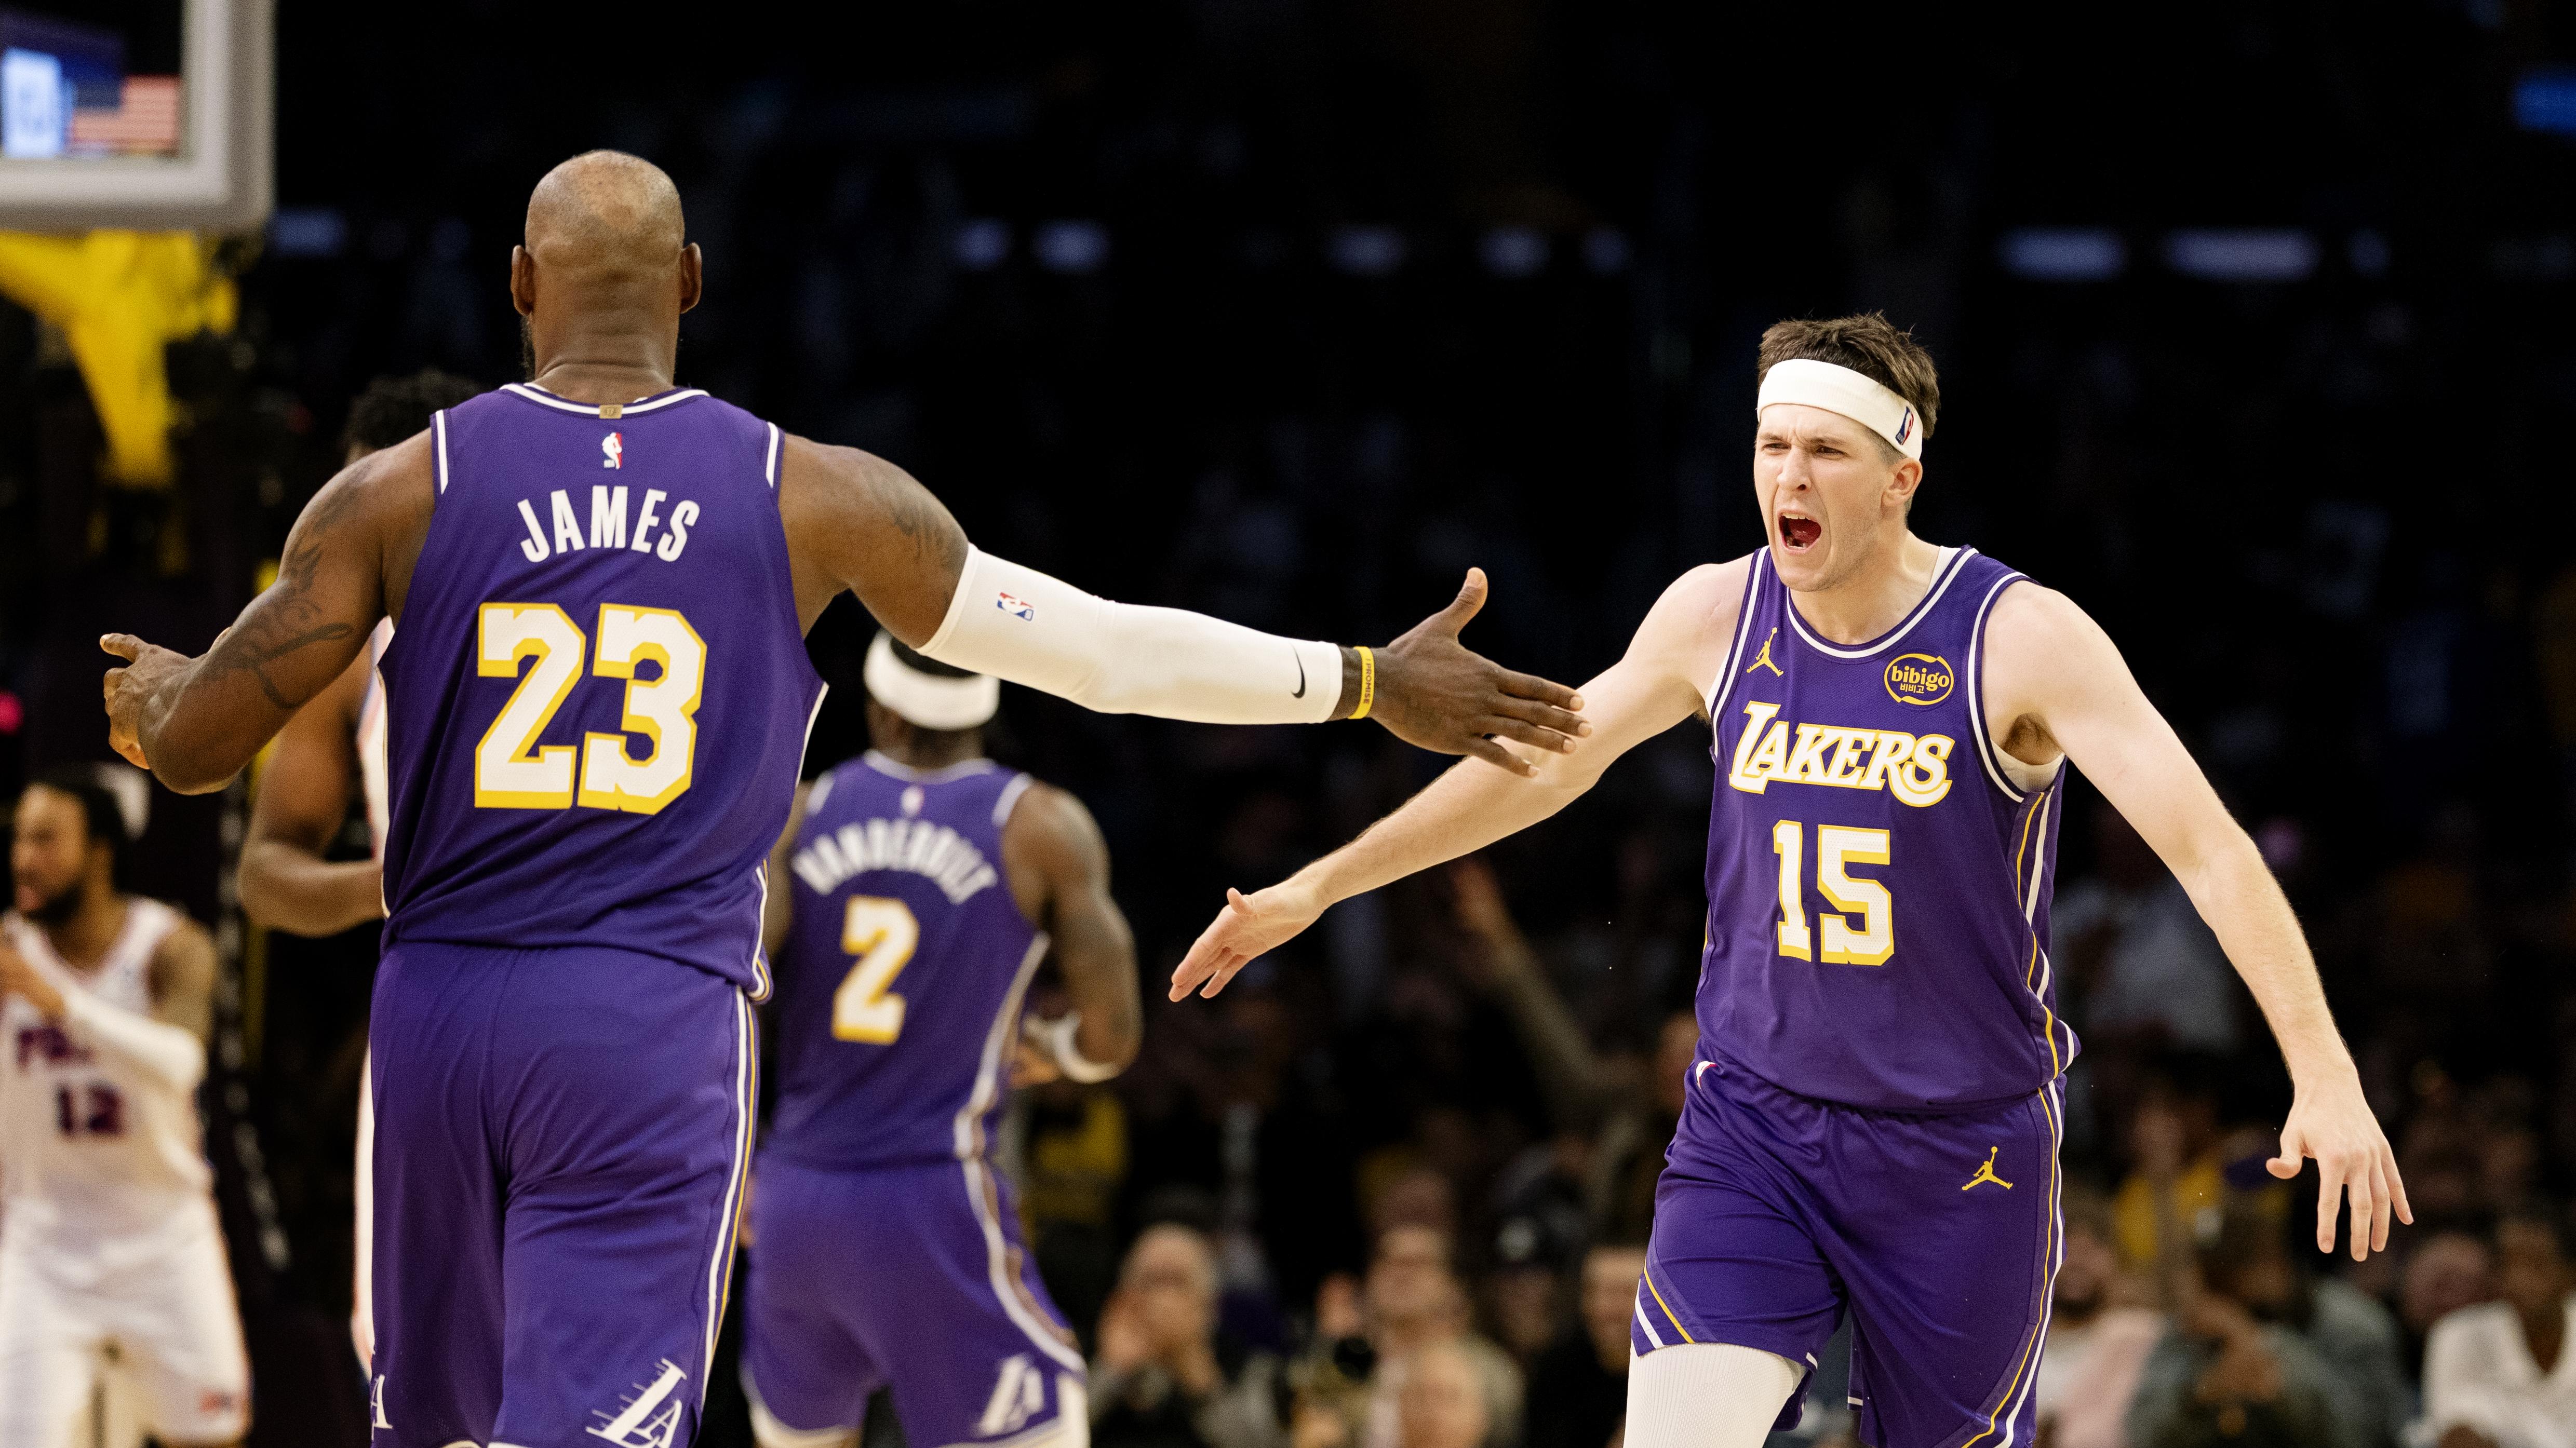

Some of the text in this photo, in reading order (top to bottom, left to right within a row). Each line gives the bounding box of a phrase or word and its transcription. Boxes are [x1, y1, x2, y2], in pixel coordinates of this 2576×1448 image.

[517, 485, 700, 563] JAMES
[475, 602, 707, 815] 23
[1891, 666, 1950, 692] bibigo
[1900, 683, 1924, 694] 비비고
[1728, 700, 1955, 807] LAKERS
[1773, 819, 1895, 966] 15
[833, 895, 919, 1045] 2
